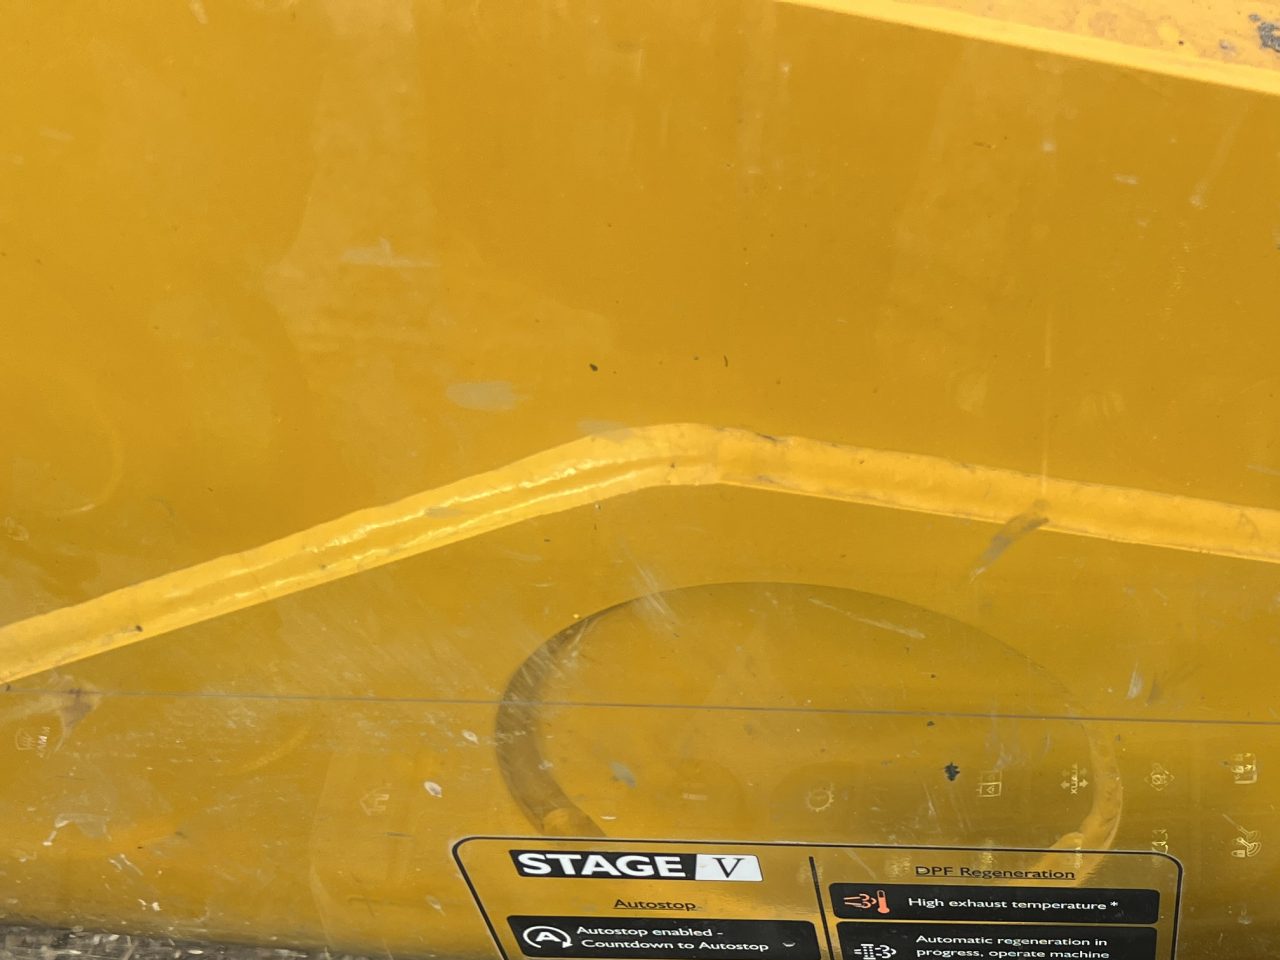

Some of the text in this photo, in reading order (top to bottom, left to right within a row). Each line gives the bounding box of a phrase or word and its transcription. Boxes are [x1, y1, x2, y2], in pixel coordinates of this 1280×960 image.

[517, 853, 744, 879] STAGE V
[914, 865, 1076, 880] DPF Regeneration
[613, 898, 697, 911] Autostop
[908, 897, 944, 909] High
[948, 898, 1008, 909] exhaust
[576, 926, 649, 938] Autostop
[651, 927, 713, 938] enabled
[580, 939, 770, 952] Countdown to Autostop
[915, 935, 1108, 948] Automatic regeneration in
[988, 949, 1046, 960] operate
[1049, 948, 1110, 959] machine
